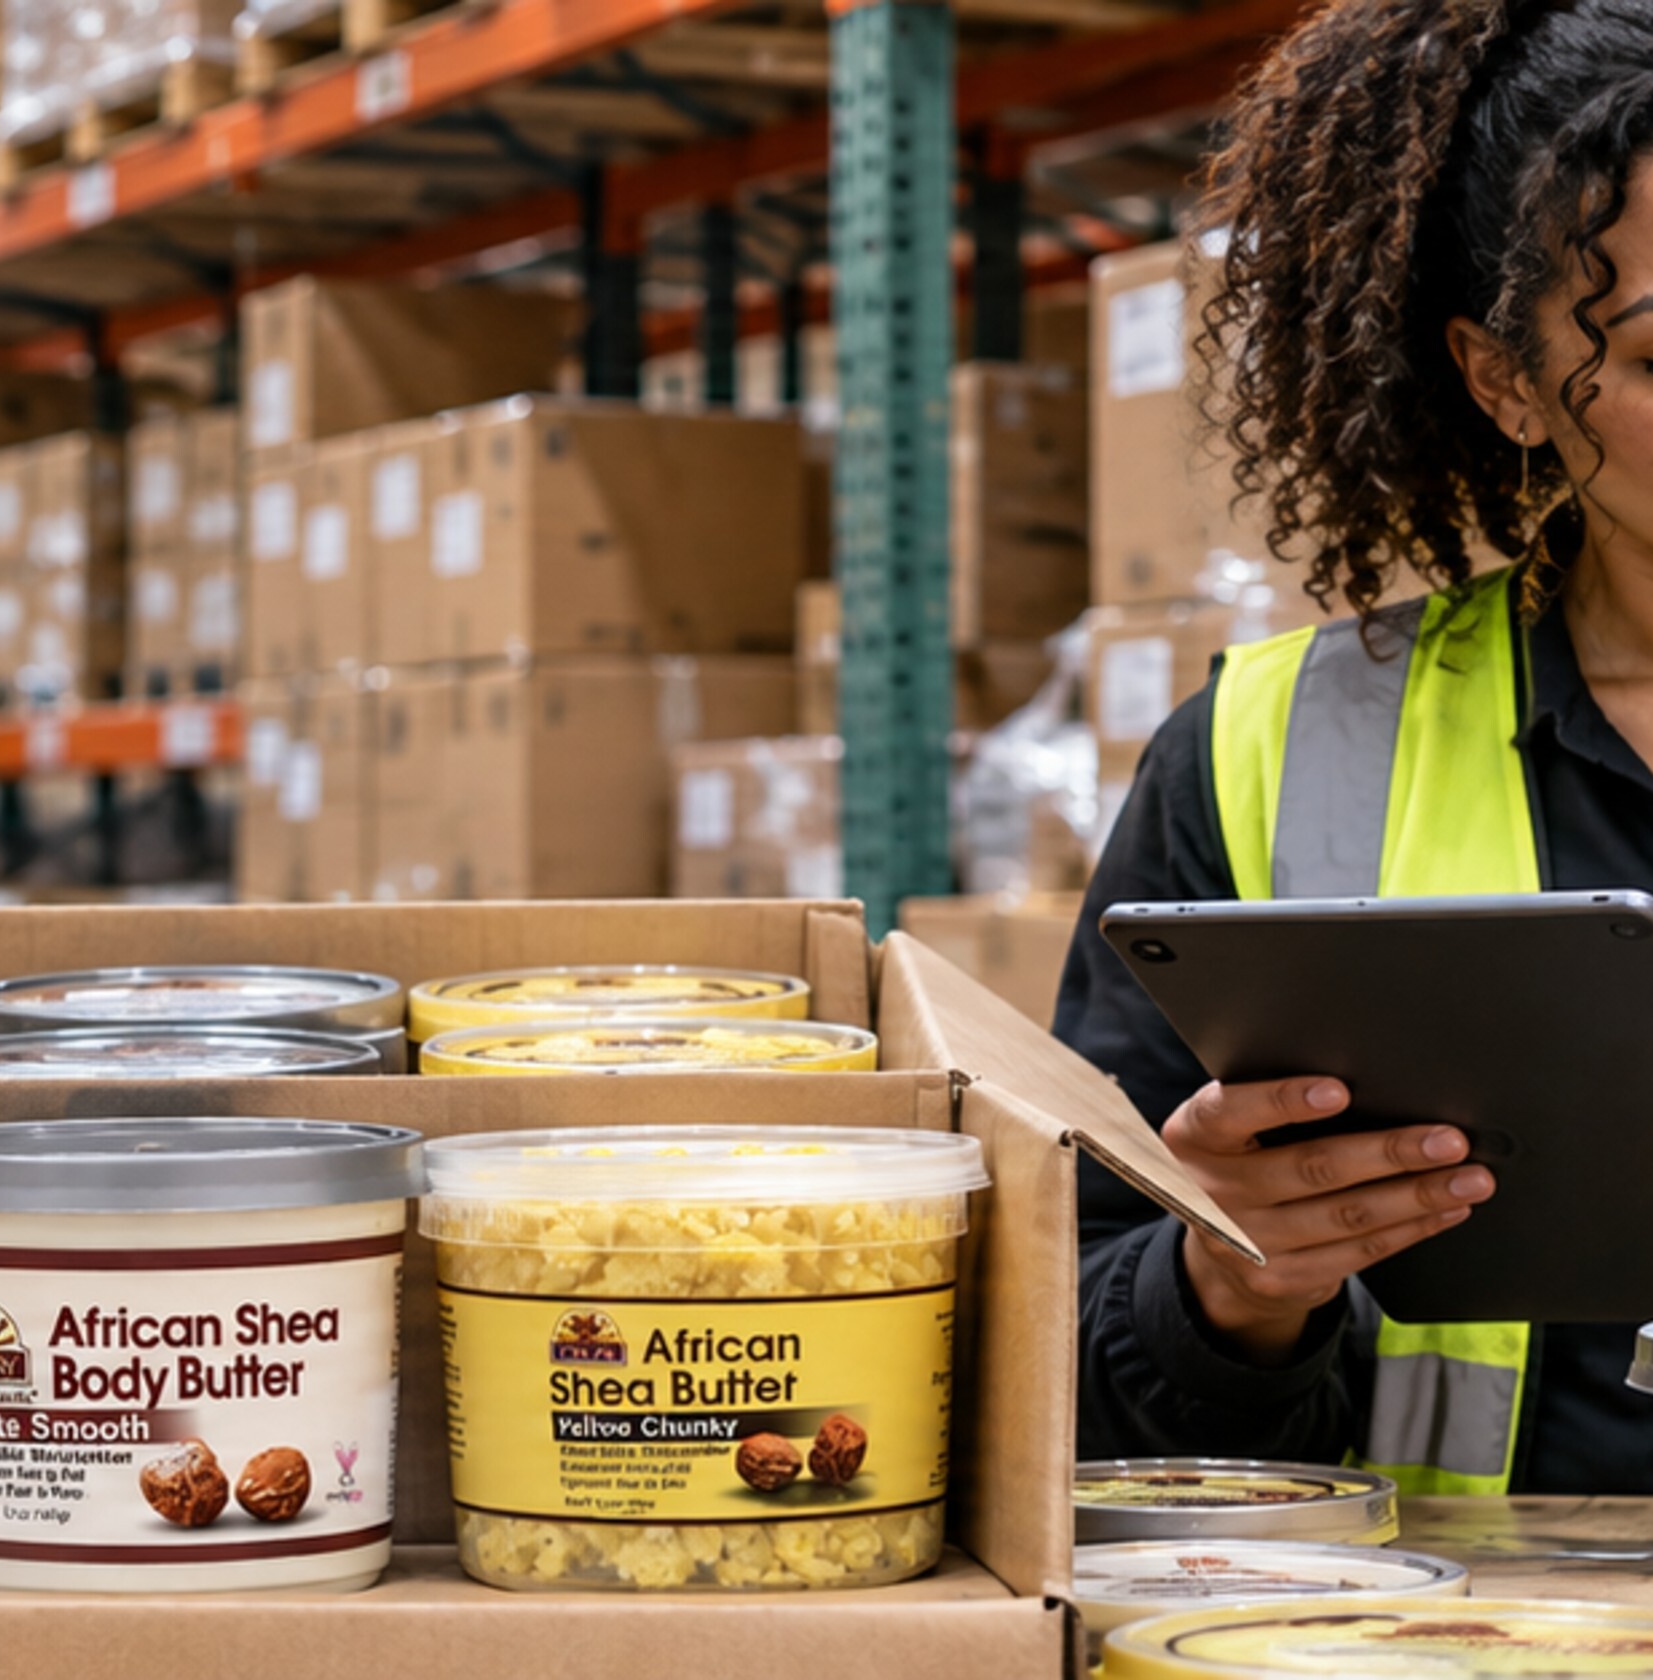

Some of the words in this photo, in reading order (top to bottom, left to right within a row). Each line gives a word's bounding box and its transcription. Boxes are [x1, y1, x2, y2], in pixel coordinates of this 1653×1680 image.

[49, 1306, 222, 1348] African
[235, 1303, 339, 1345] Shea
[643, 1328, 801, 1364] African
[52, 1355, 169, 1409] Body
[178, 1354, 304, 1400] Butter
[549, 1370, 655, 1406] Shea
[31, 1412, 149, 1441] Smooth
[640, 1415, 738, 1439] Chunky
